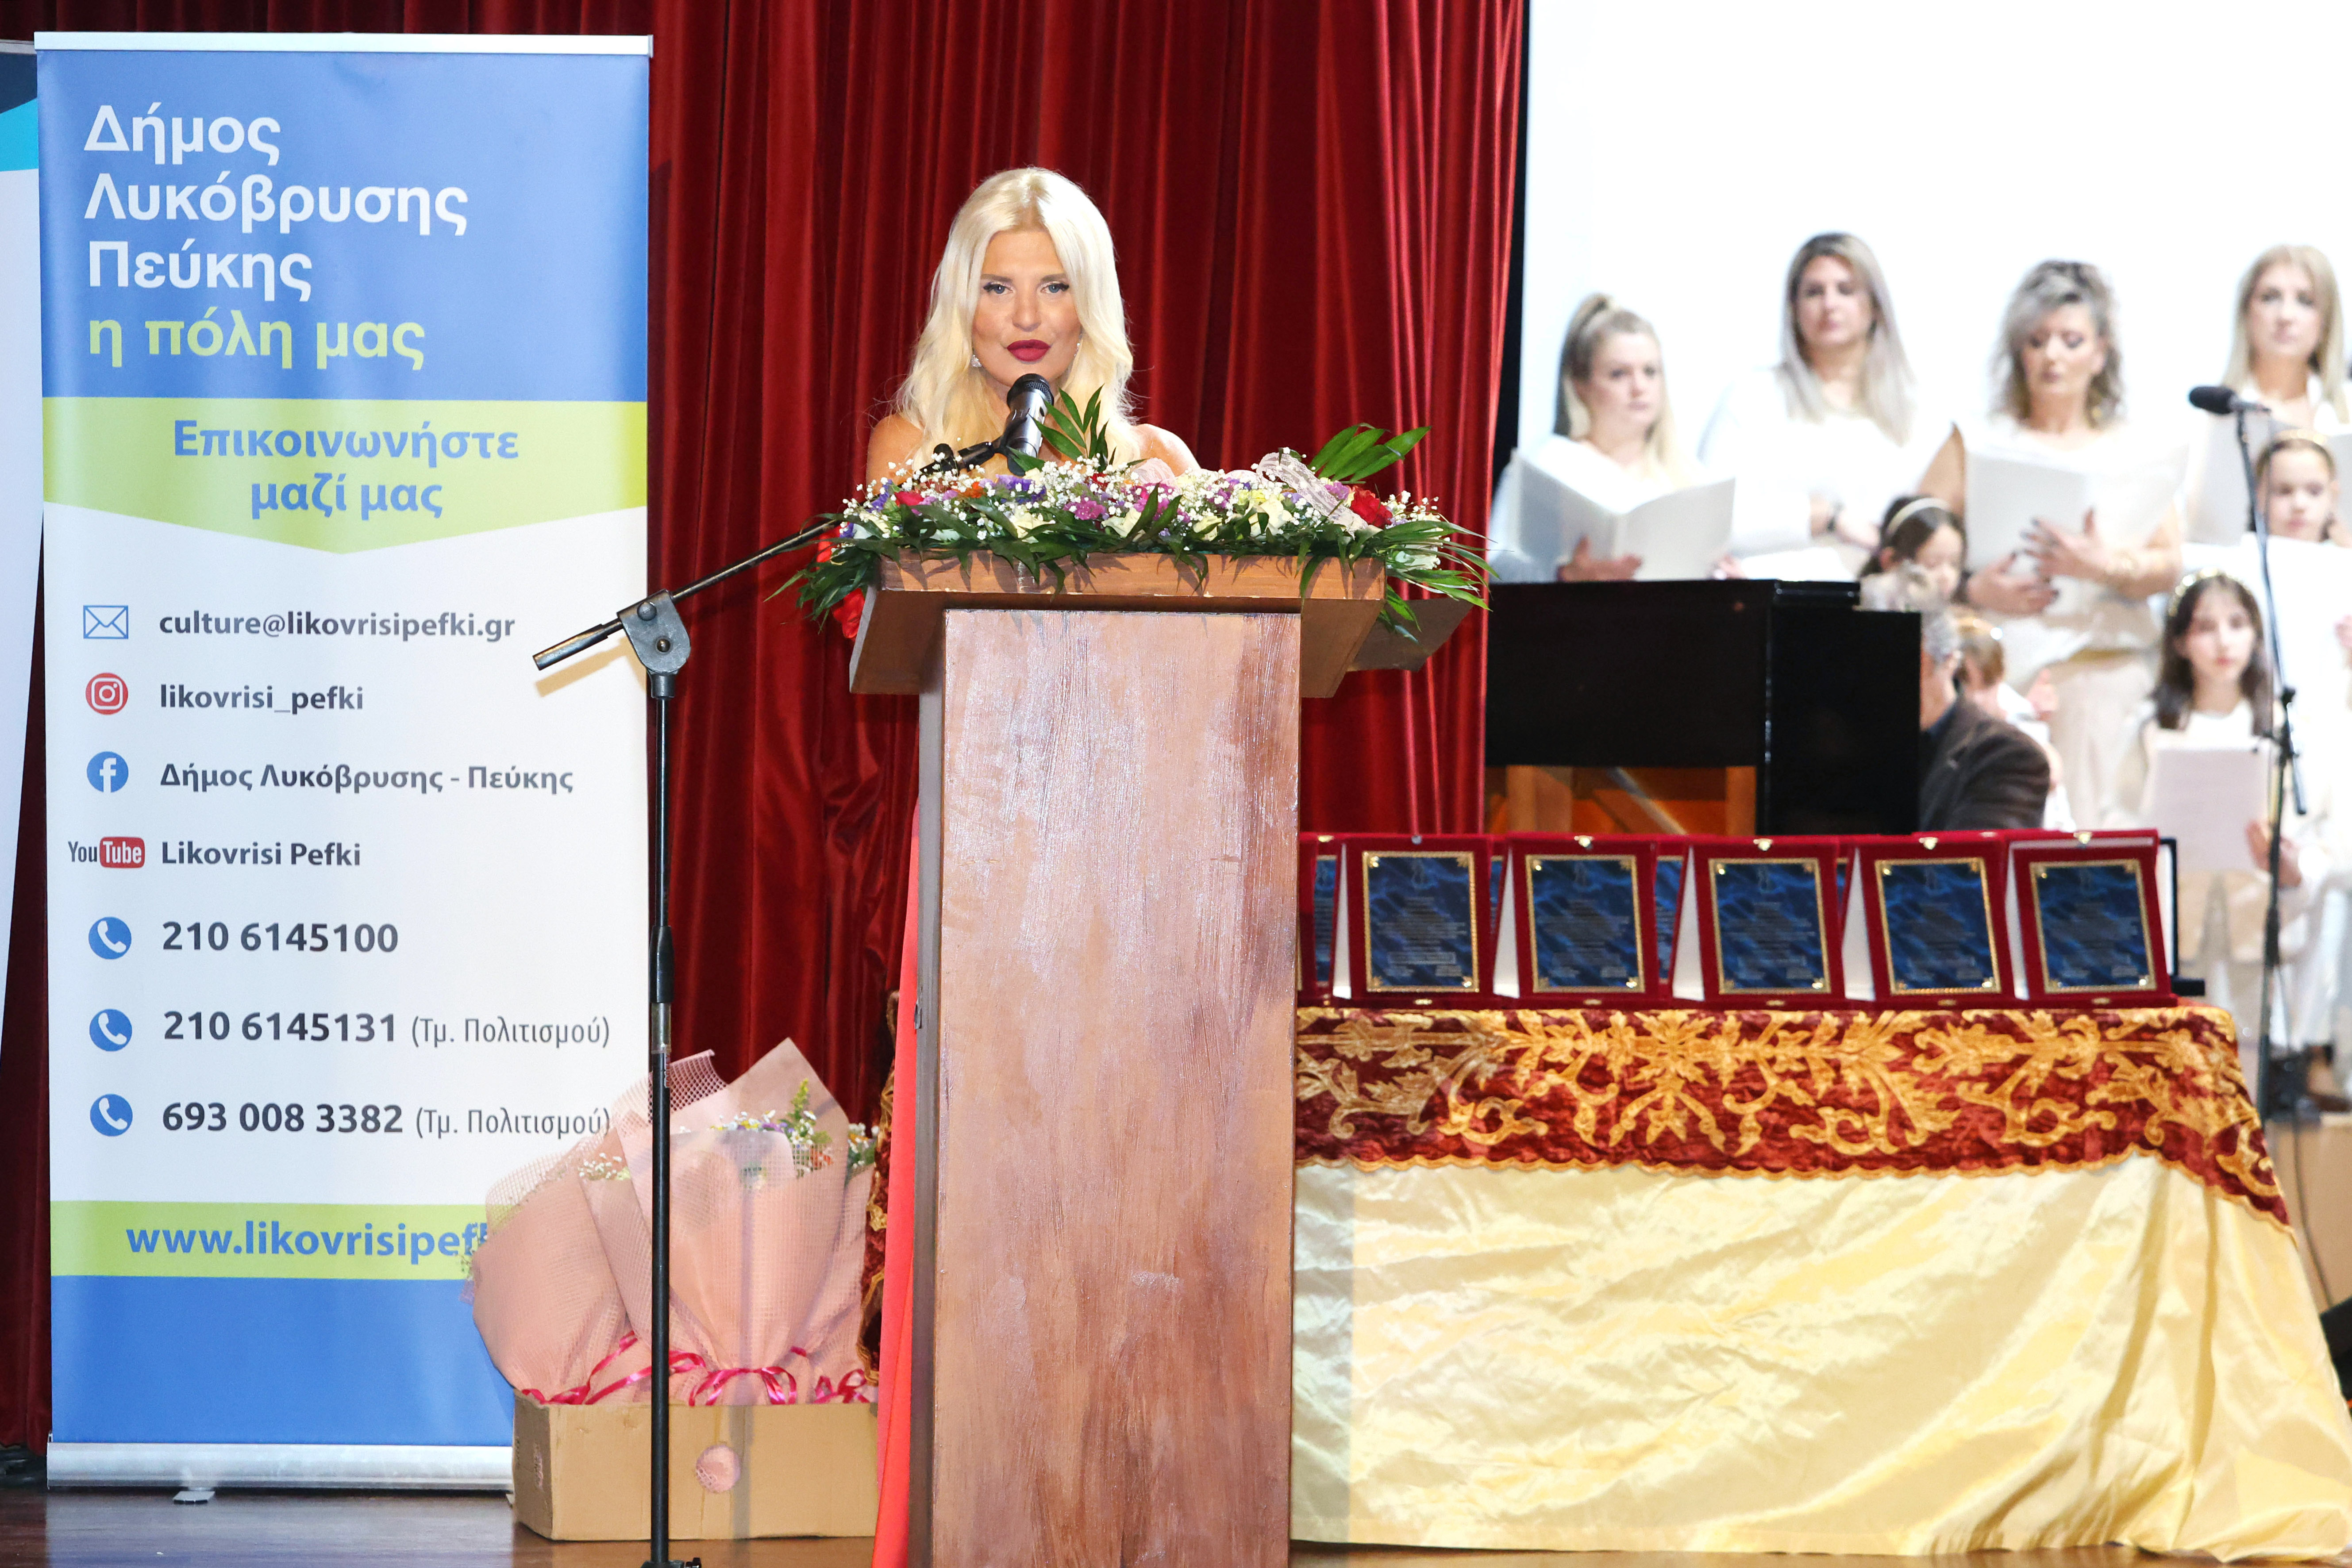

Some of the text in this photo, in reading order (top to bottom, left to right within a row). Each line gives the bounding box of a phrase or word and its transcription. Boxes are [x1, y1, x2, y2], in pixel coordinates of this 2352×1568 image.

[85, 103, 280, 165] Δήμος
[85, 171, 468, 235] Λυκόβρυσης
[90, 238, 312, 301] Πεύκης
[90, 307, 424, 370] η πόλη μας
[175, 420, 519, 469] Επικοινωνήστε
[251, 473, 443, 521] μαζί μας
[160, 611, 515, 642] culture@likovrisipefki.gr
[160, 684, 363, 715] likovrisi_pefki
[160, 763, 253, 792] Δήμος
[260, 764, 443, 794] Λυκόβρυσης
[469, 765, 574, 795] Πεύκης
[162, 841, 360, 866] Likovrisi Pefki
[162, 922, 398, 953] 210 6145100
[164, 1011, 609, 1048] 210 6145131 (Τμ. Πολιτισμού)
[162, 1102, 610, 1139] 693 008 3382 (Τμ. Πολιτισμού)
